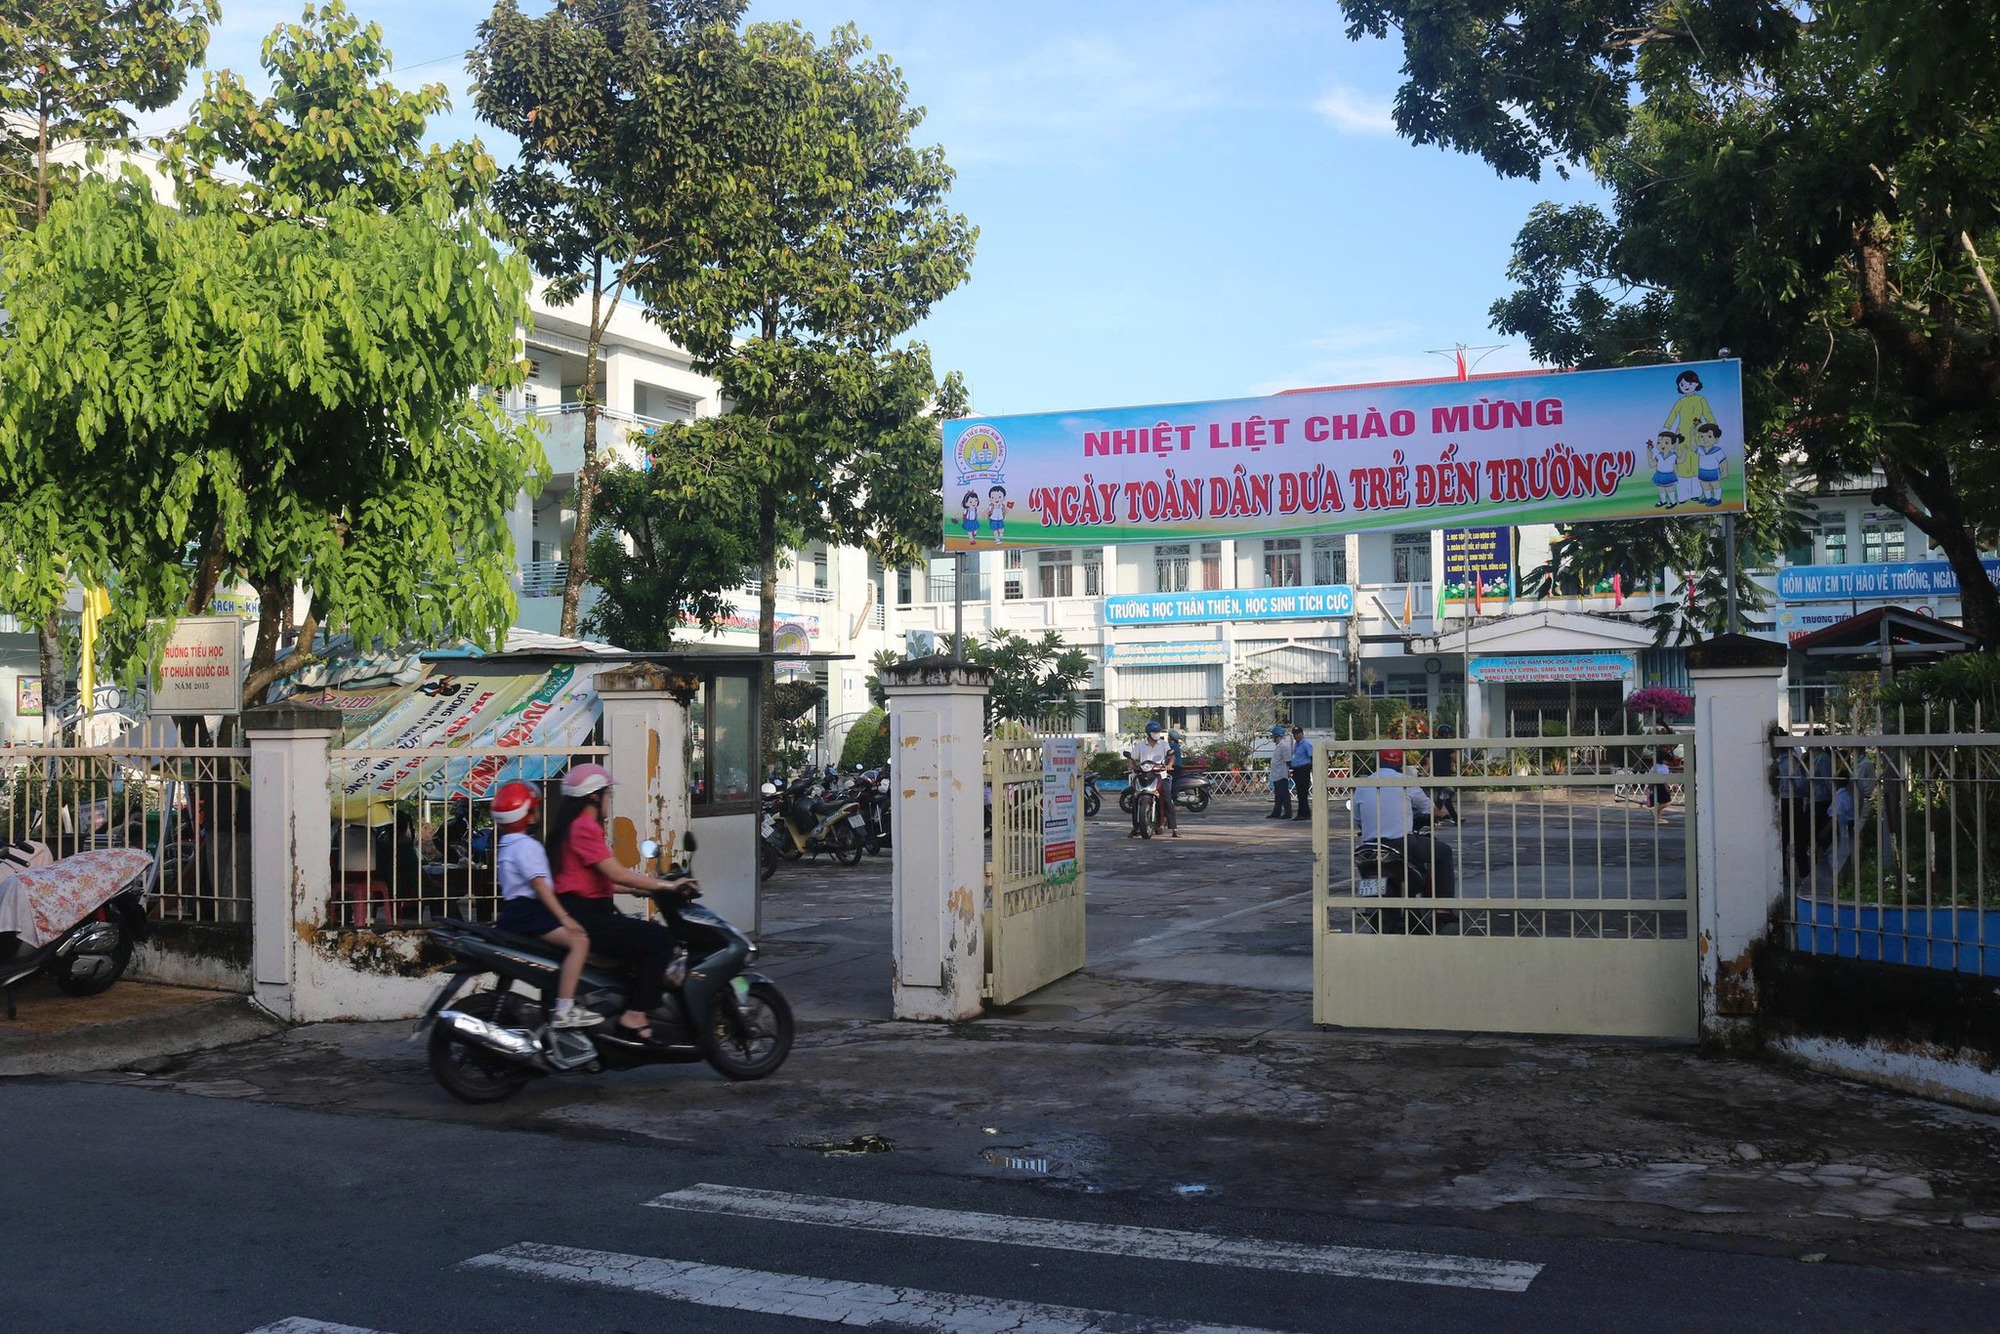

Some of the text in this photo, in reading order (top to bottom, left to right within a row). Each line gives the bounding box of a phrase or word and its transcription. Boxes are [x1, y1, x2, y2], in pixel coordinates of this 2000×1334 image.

[1084, 398, 1563, 457] NHIỆT LIỆT CHÀO MỪNG
[1125, 468, 1203, 522] TOÀN
[1209, 464, 1273, 517] DÂN
[1279, 463, 1345, 513] ĐƯA
[1350, 449, 1410, 511] TRẺ
[1415, 443, 1480, 505] ĐẾN
[1782, 565, 1957, 595] HÔM NAY EM TỰ HÀO VỀ TRƯỜNG, NGÀY
[1109, 592, 1349, 620] TRƯỜNG HỌC THÂN THIỆN, HỌC SINH TÍCH CỰC
[165, 641, 224, 660] RƯỜNG TIỂU HỌC
[170, 661, 194, 678] CHUẨN
[195, 661, 215, 677] QUỐC
[217, 665, 230, 677] GIA
[175, 682, 209, 690] NĂM 2015
[440, 682, 479, 717] TRƯỜNG
